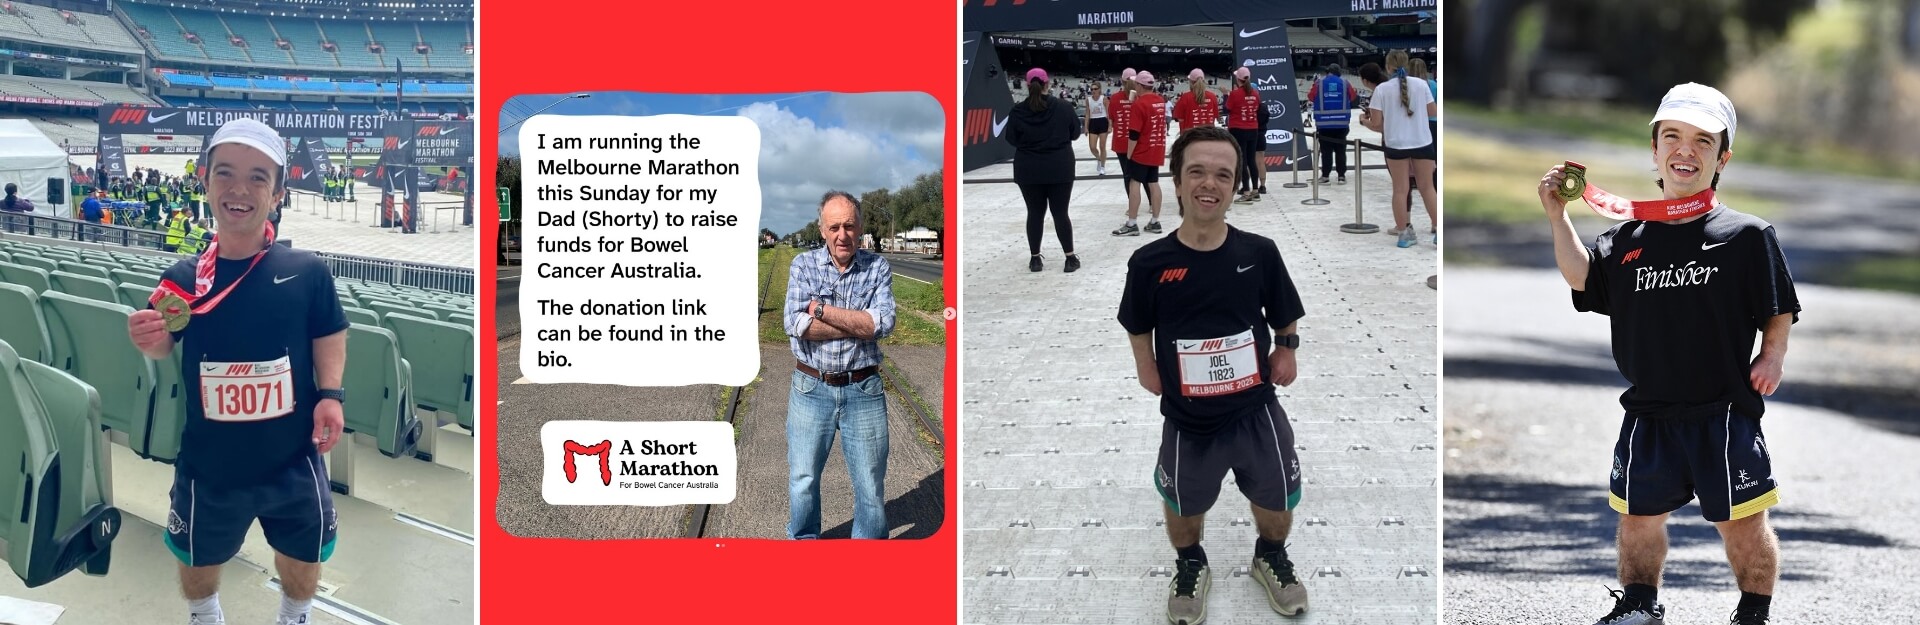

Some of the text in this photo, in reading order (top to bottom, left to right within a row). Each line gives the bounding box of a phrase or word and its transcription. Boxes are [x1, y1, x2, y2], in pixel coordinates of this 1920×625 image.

[1351, 0, 1437, 11] HALF MARATHO
[1078, 11, 1134, 25] MARATHON
[999, 37, 1023, 45] GARMIN
[275, 113, 345, 129] MARATHON
[416, 138, 460, 148] MELBOURNE
[1266, 132, 1290, 140] choll
[416, 148, 455, 157] MARATHON
[1635, 260, 1719, 292] Finisher
[1209, 354, 1230, 368] JOEL
[1208, 367, 1235, 382] 11823
[1189, 376, 1254, 395] MELBOURNE 2025
[215, 380, 283, 416] 13071
[1735, 479, 1759, 491] KUKRI
[102, 518, 111, 537] N
